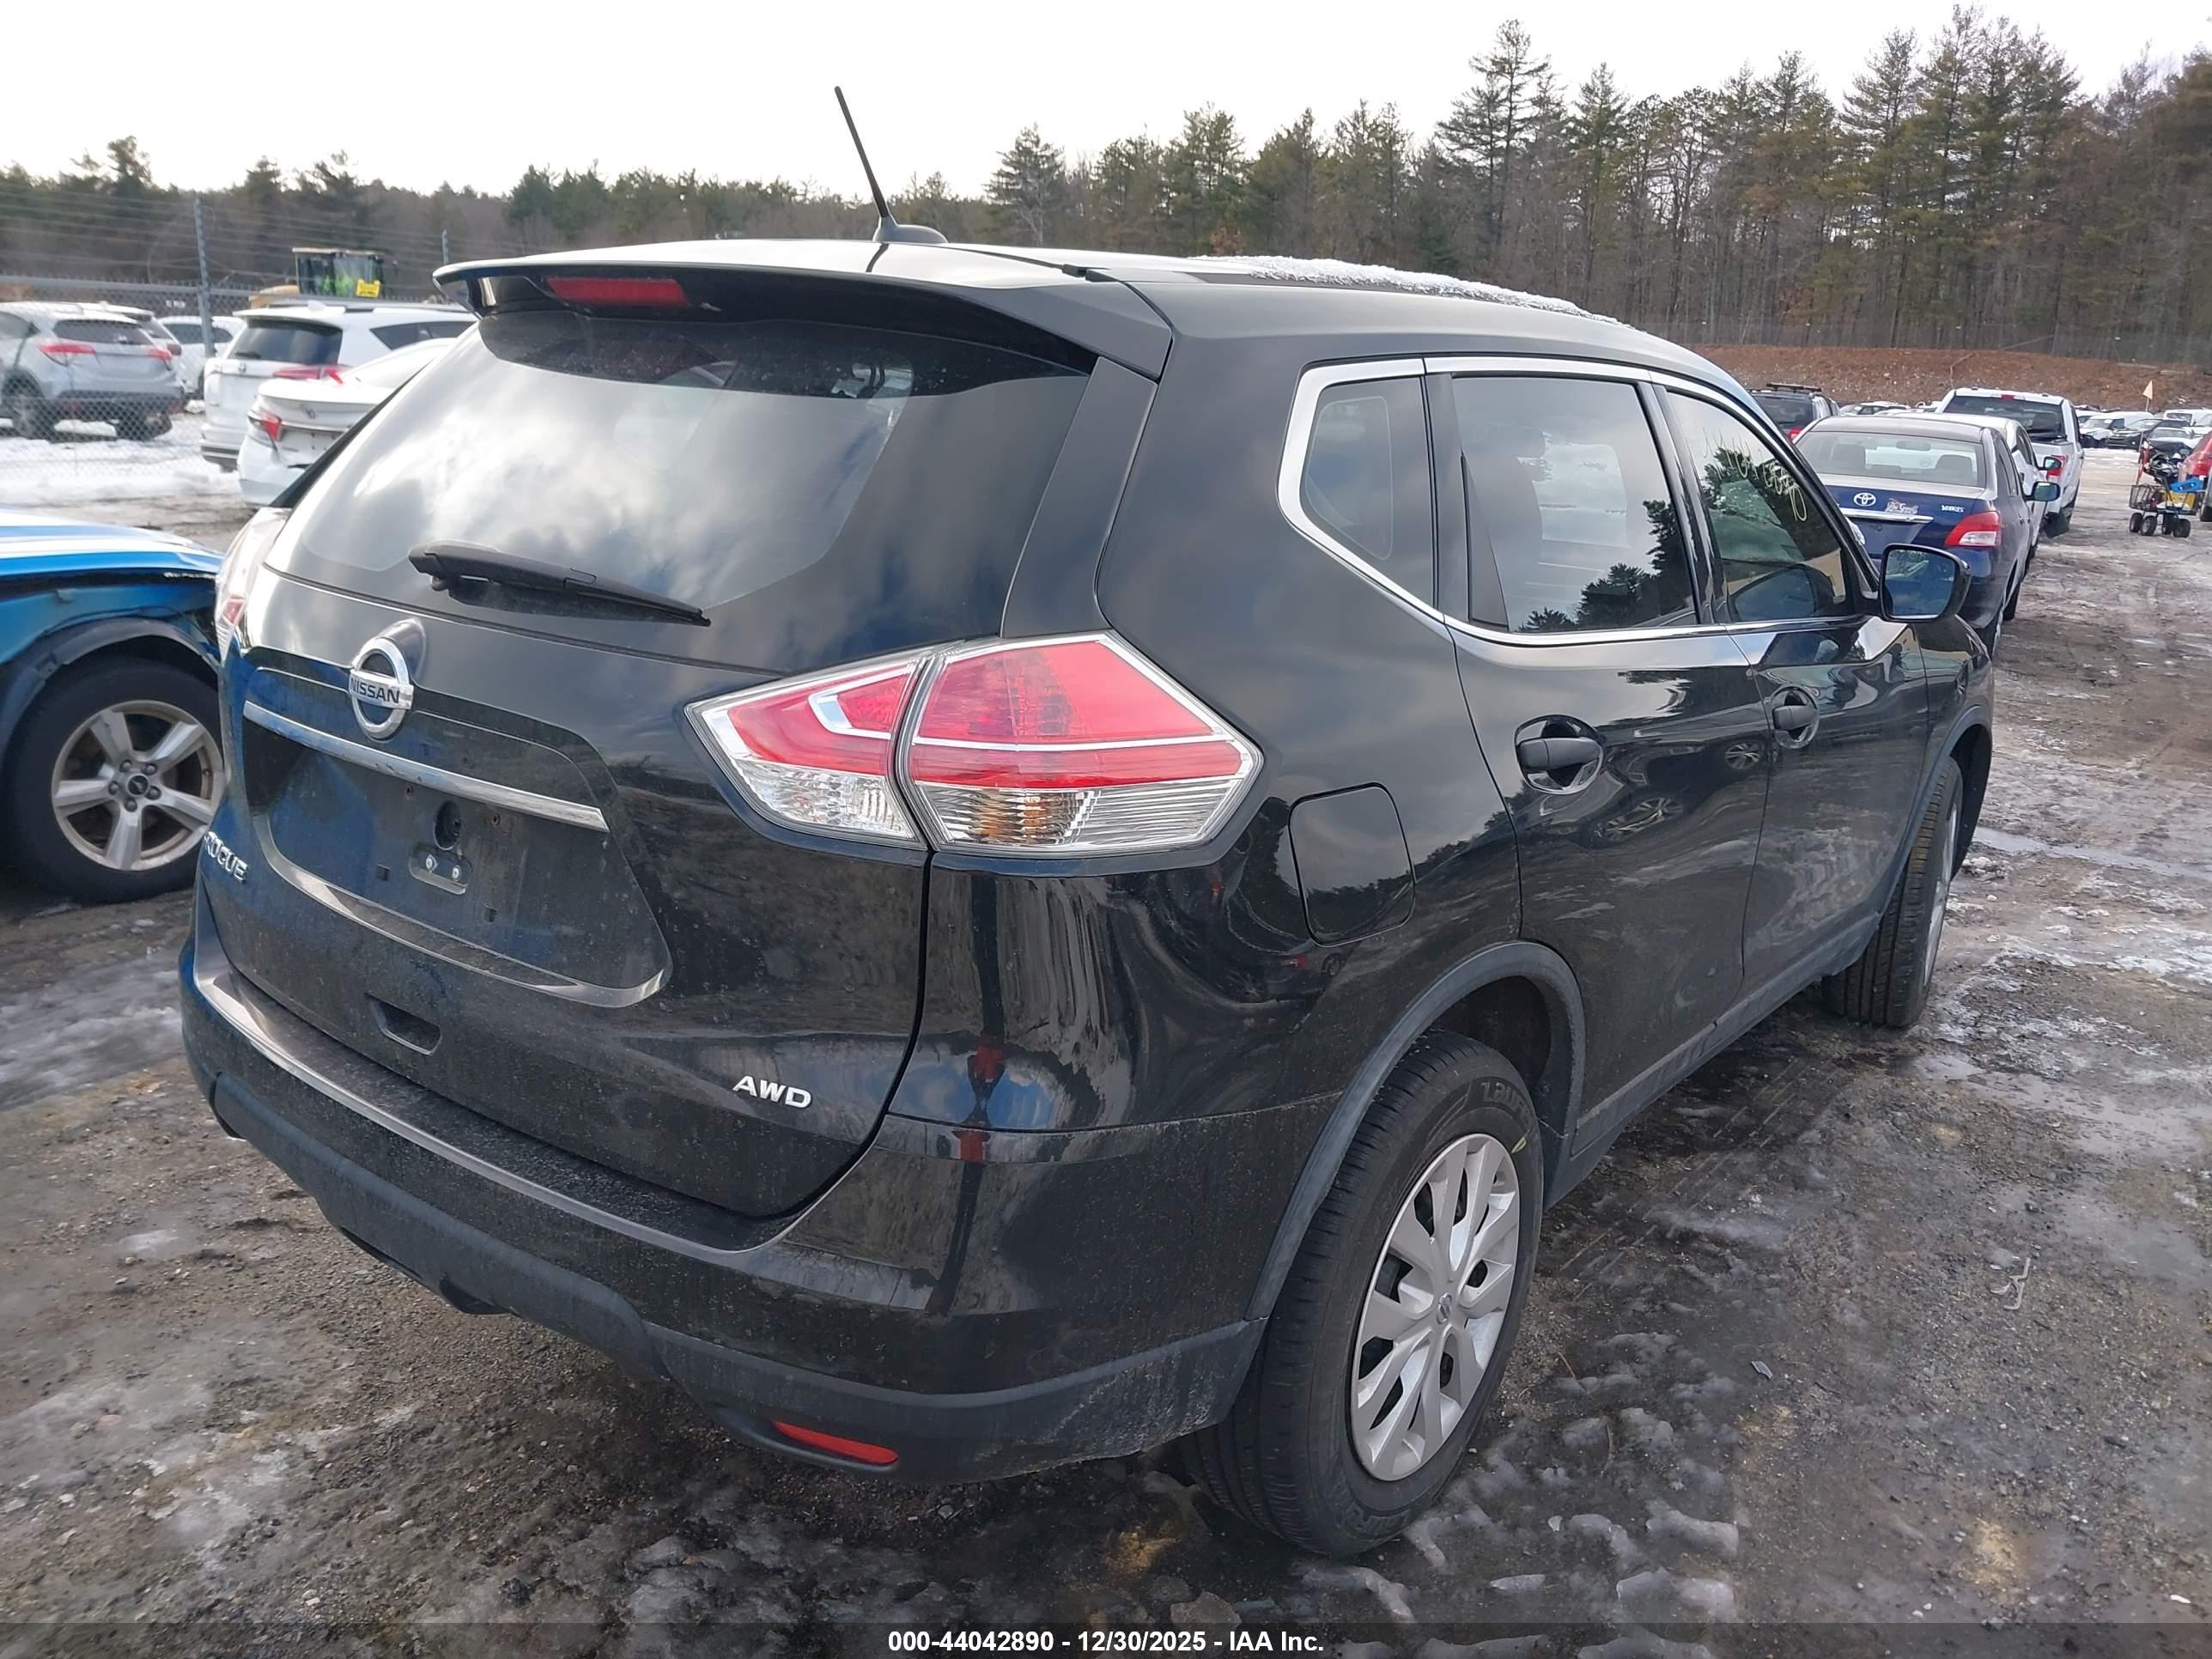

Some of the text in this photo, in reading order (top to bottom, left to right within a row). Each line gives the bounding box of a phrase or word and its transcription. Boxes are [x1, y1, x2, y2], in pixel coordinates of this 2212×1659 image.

[350, 678, 400, 703] NISSAN
[204, 831, 248, 881] ROGUE
[732, 1075, 811, 1109] AWD
